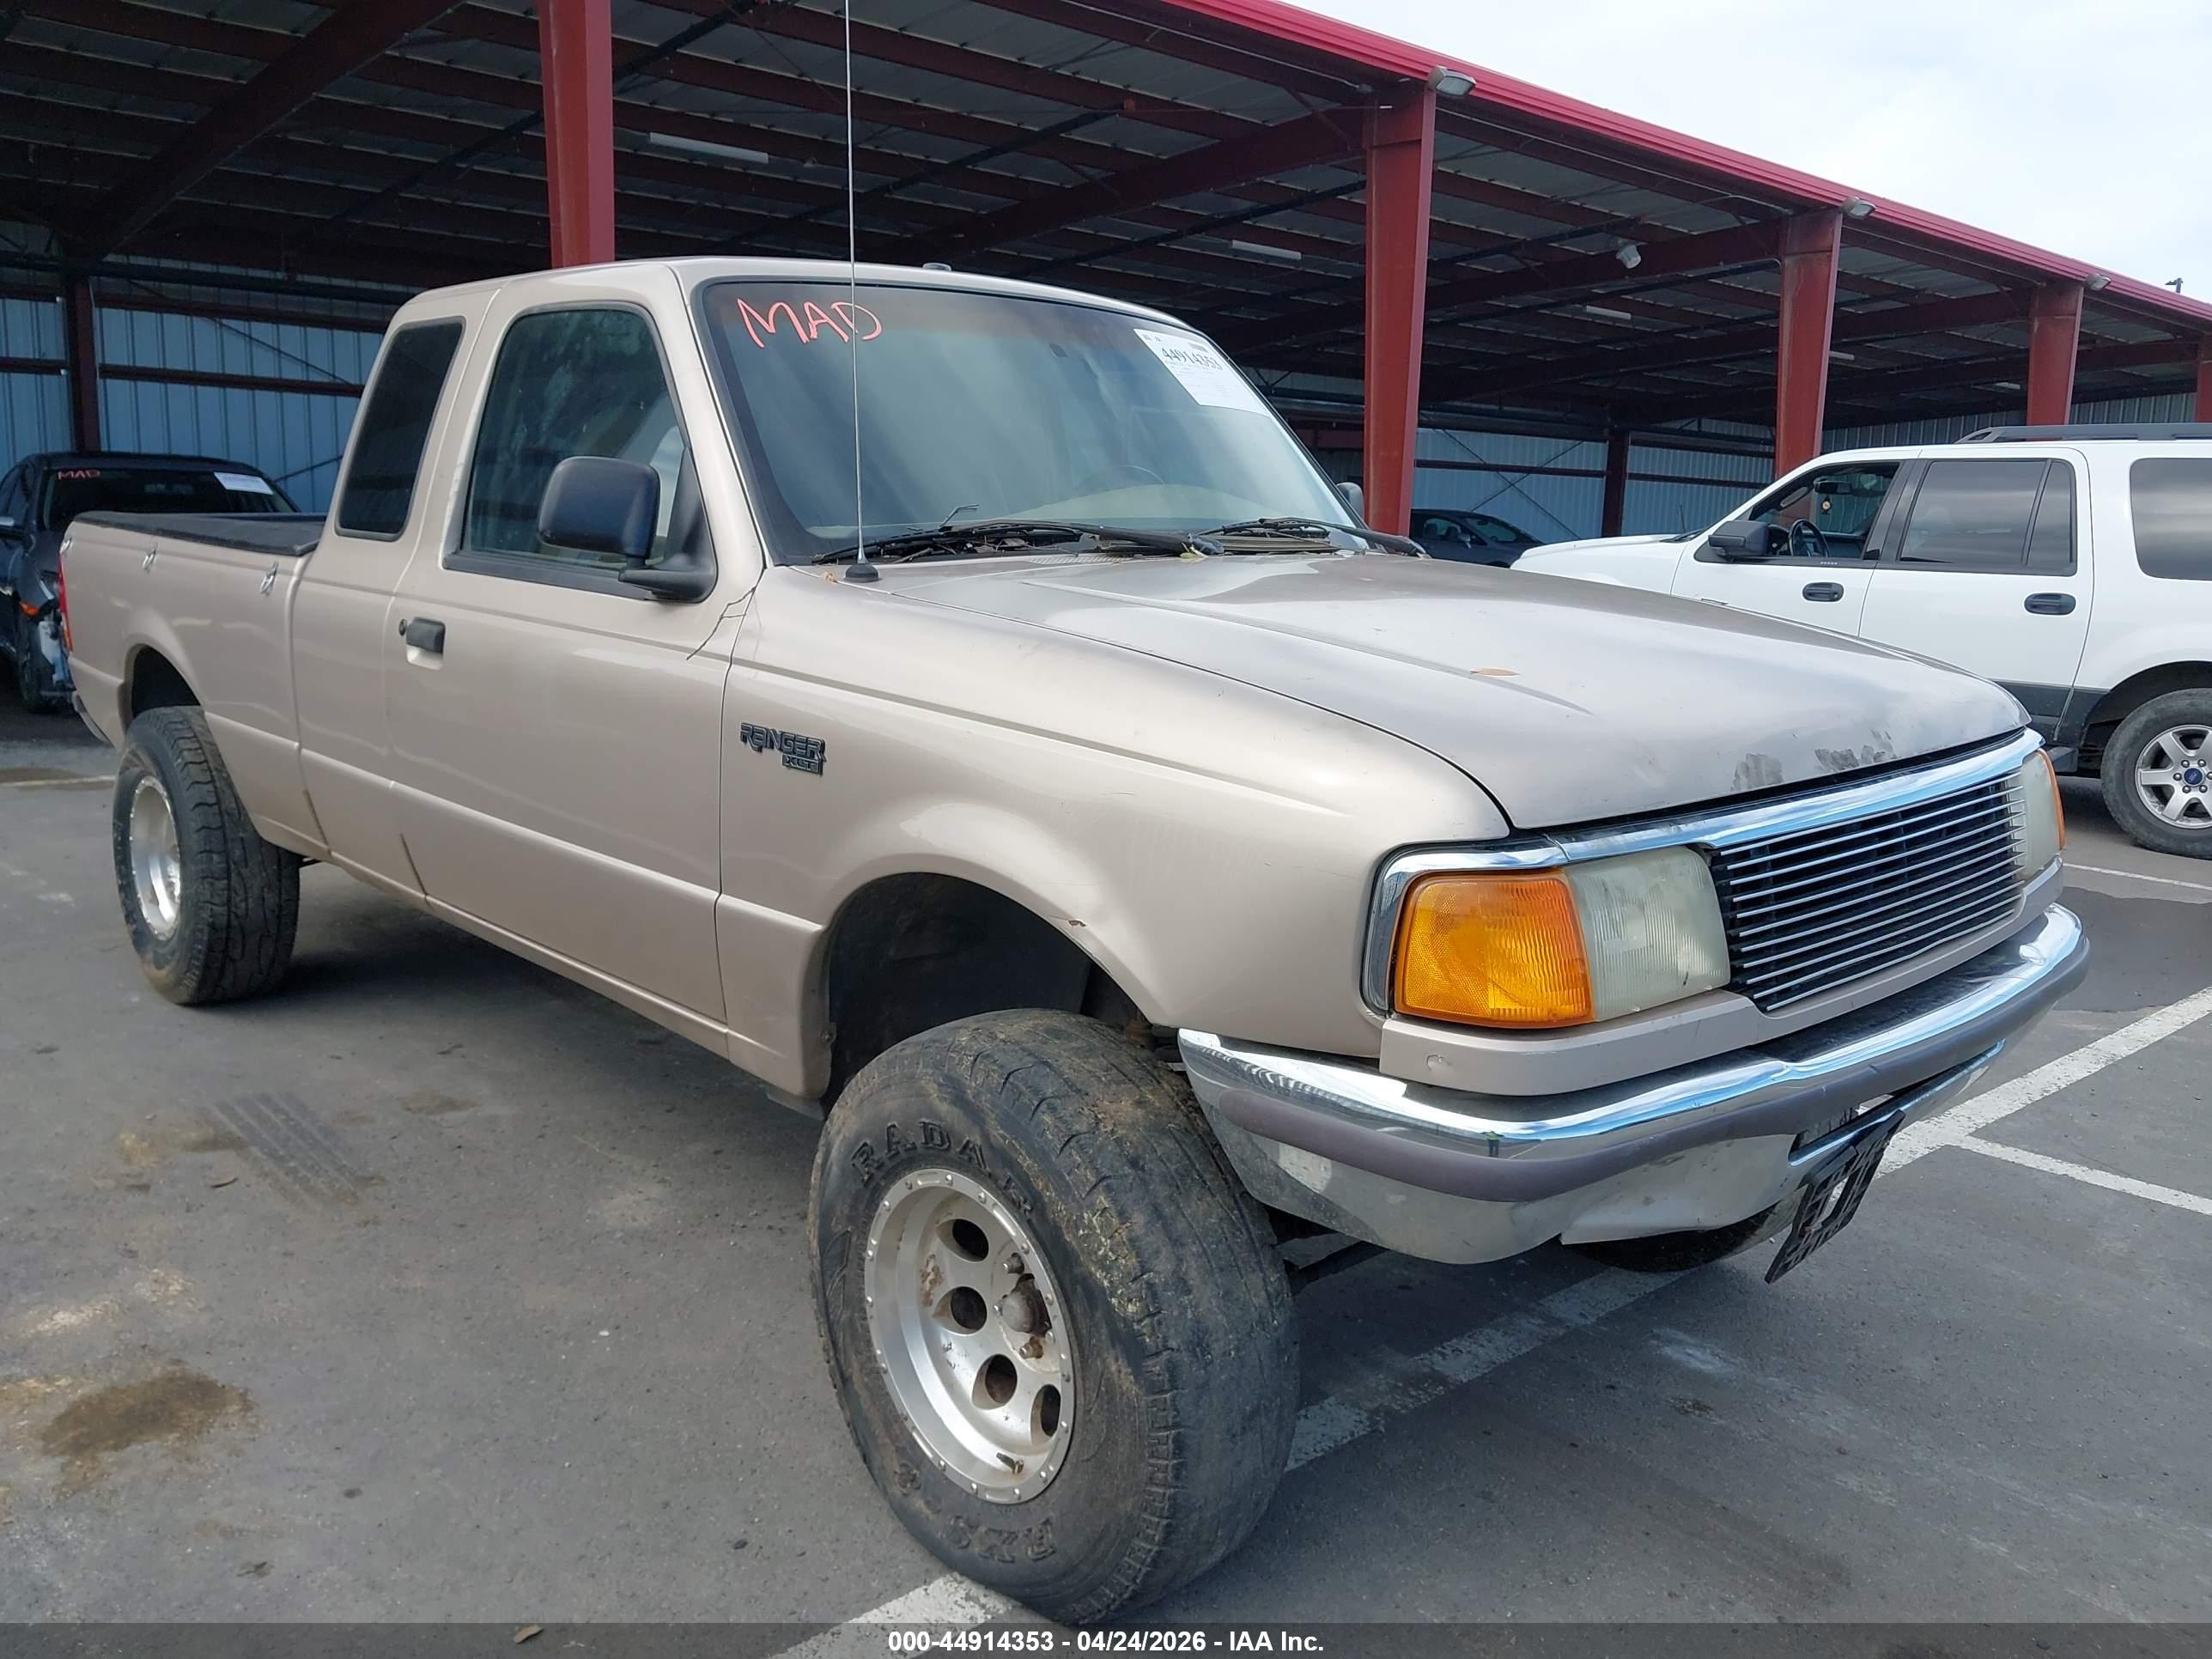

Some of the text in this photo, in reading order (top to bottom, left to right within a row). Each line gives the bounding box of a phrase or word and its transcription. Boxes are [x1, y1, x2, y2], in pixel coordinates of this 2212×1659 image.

[737, 298, 883, 349] MAD
[1162, 348, 1223, 370] 44914353
[58, 470, 100, 480] MAD
[740, 722, 826, 761] RANGER
